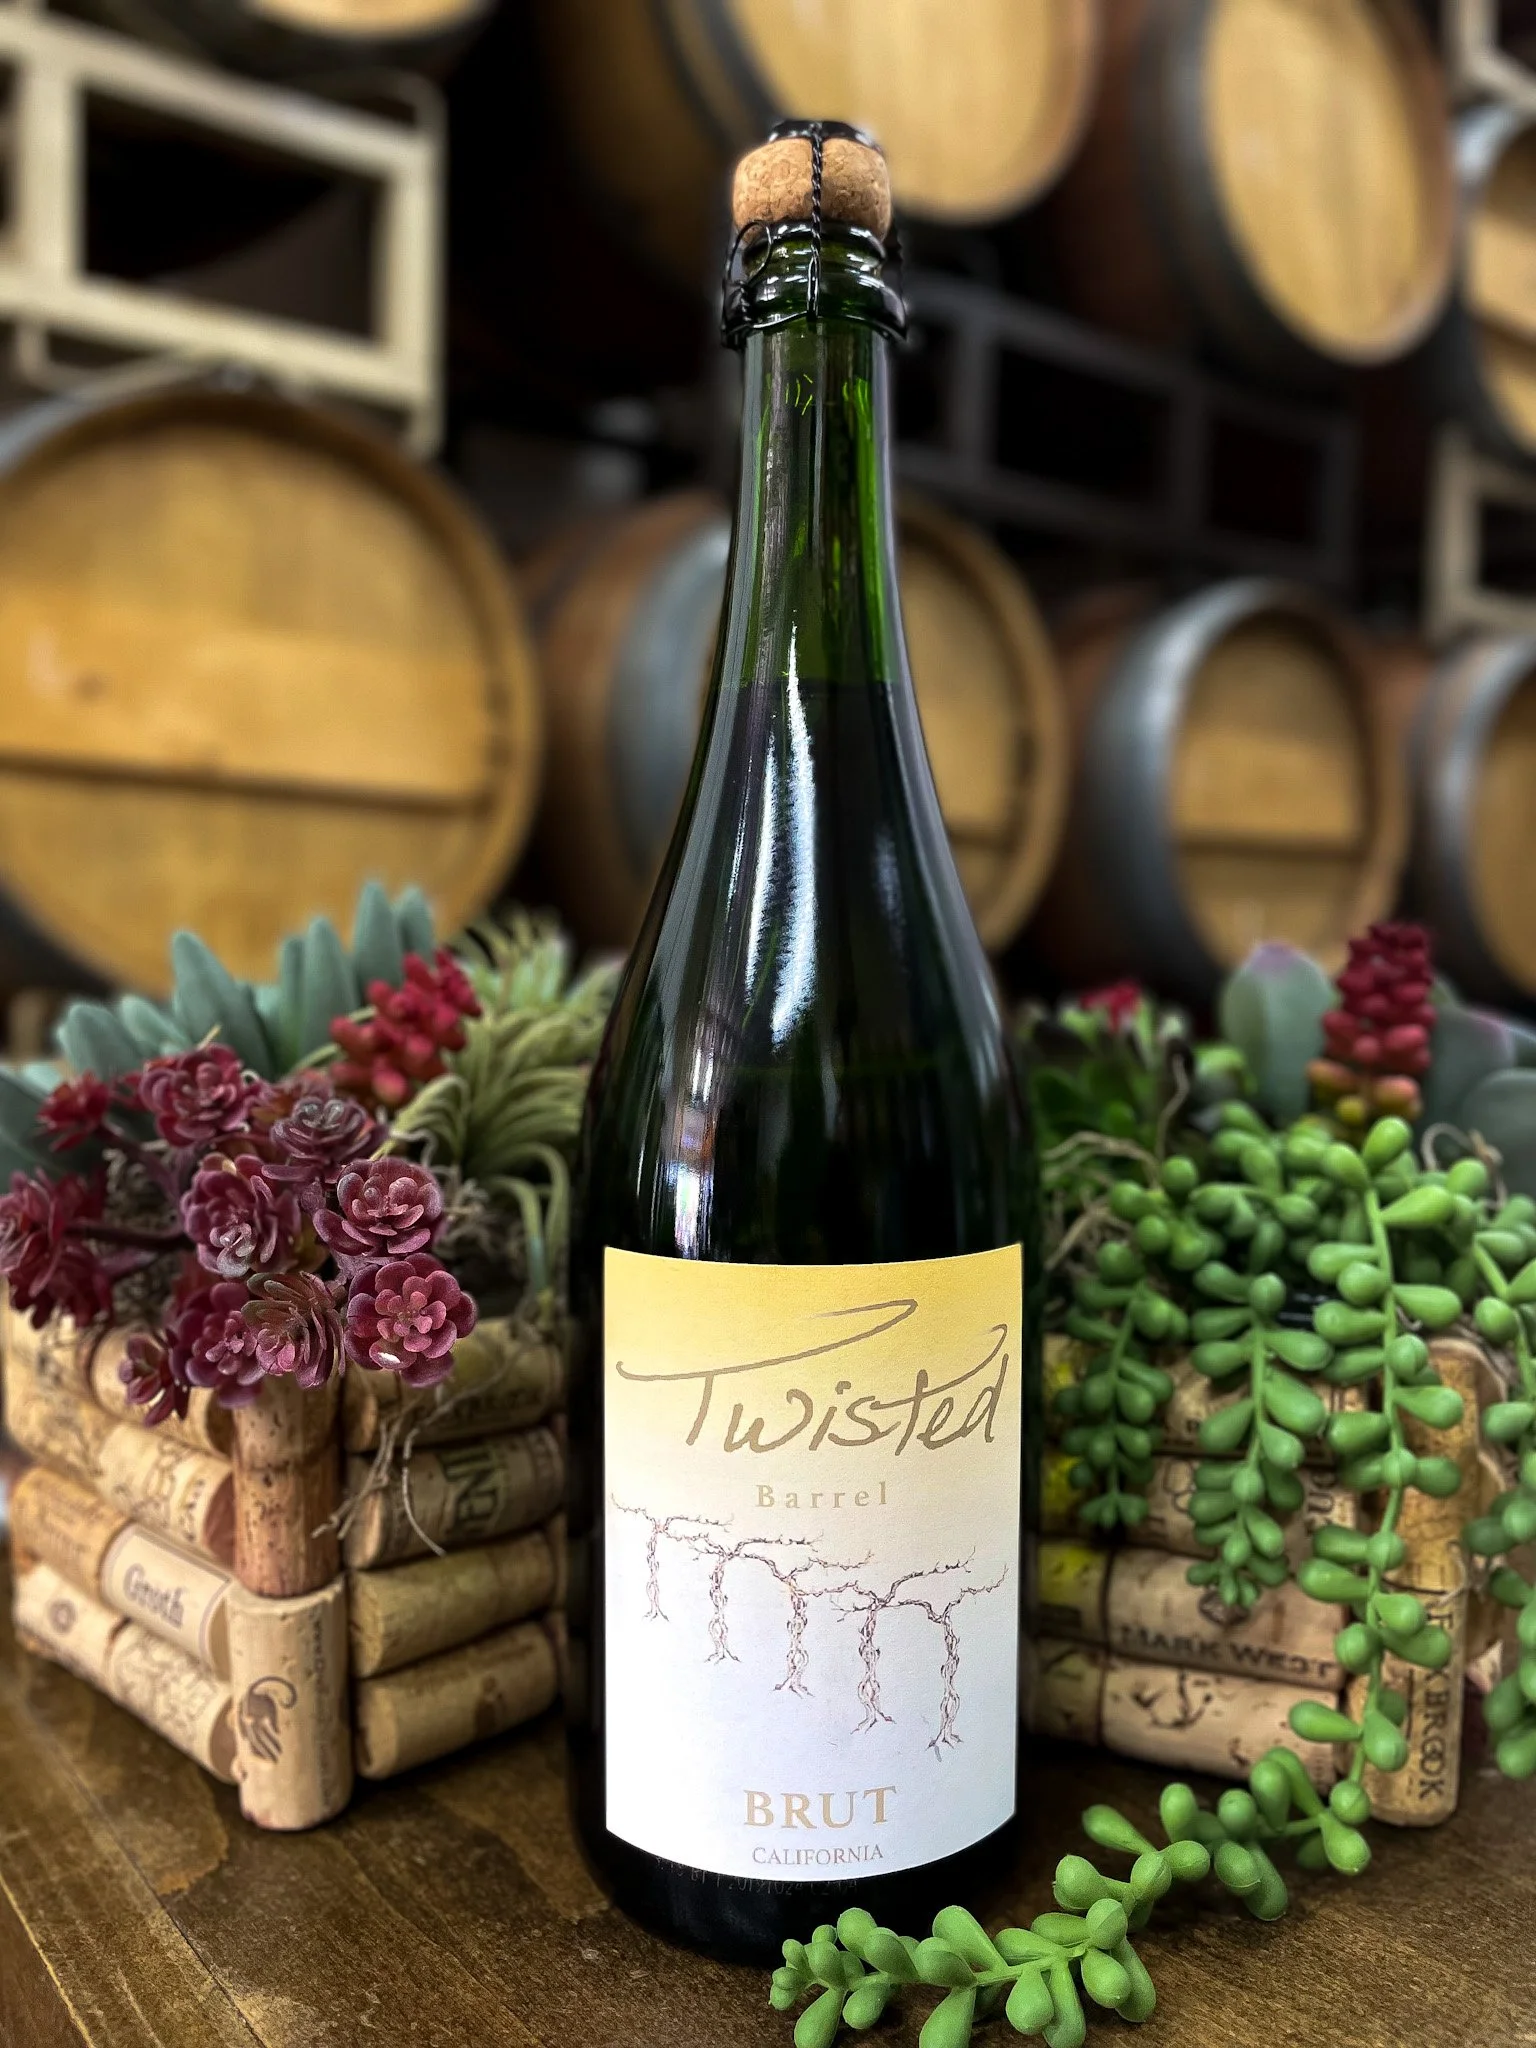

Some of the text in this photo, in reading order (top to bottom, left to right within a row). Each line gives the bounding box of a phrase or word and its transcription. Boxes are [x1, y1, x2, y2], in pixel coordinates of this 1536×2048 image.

[616, 1299, 1009, 1456] Twisted
[754, 1481, 888, 1509] Barrel
[744, 1787, 897, 1829] BRUT
[751, 1844, 884, 1867] CALIFORNIA
